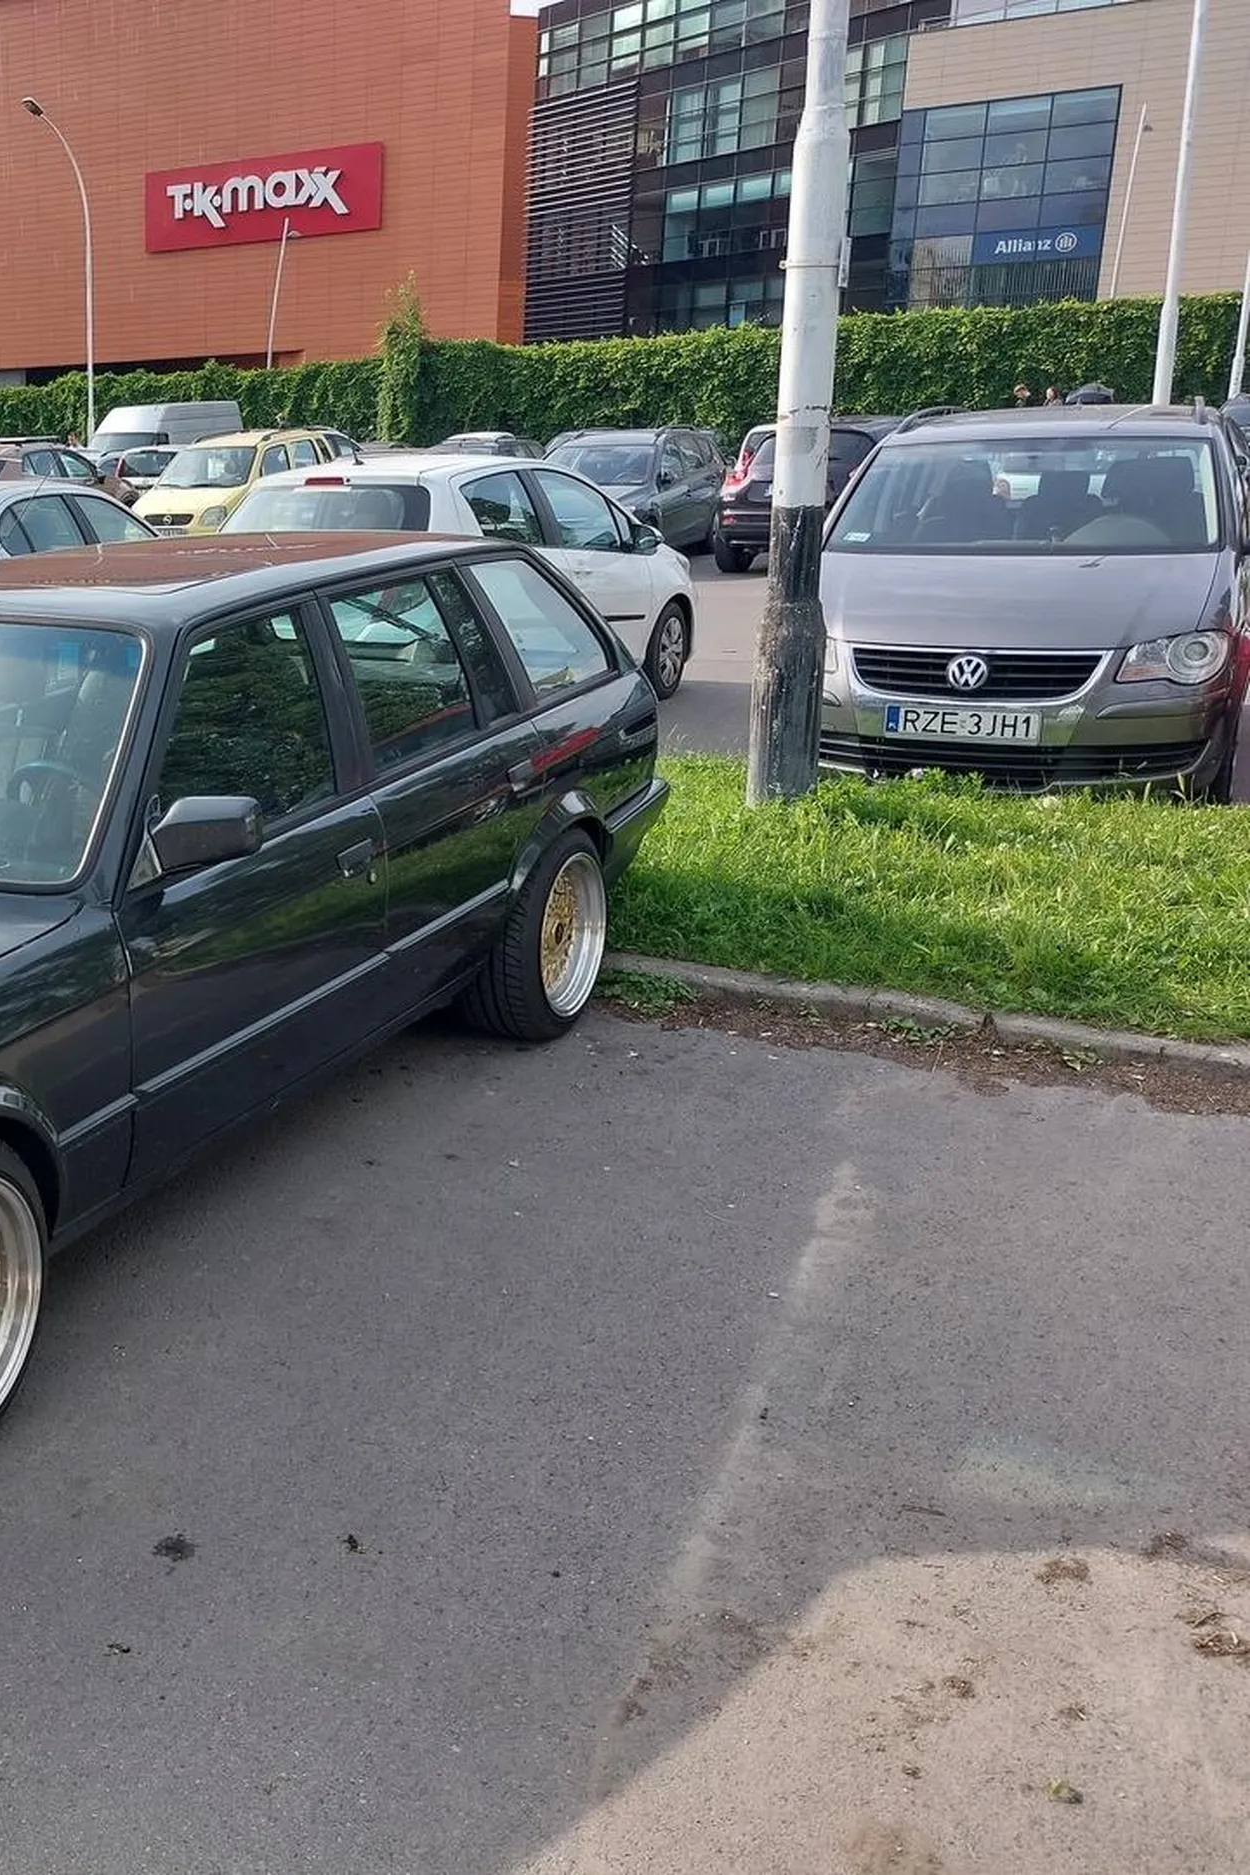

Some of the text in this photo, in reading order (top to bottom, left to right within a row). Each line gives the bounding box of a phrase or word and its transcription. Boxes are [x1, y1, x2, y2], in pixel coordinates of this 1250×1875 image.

[993, 238, 1053, 255] Allianz
[903, 709, 1031, 737] RZE 3JH1
